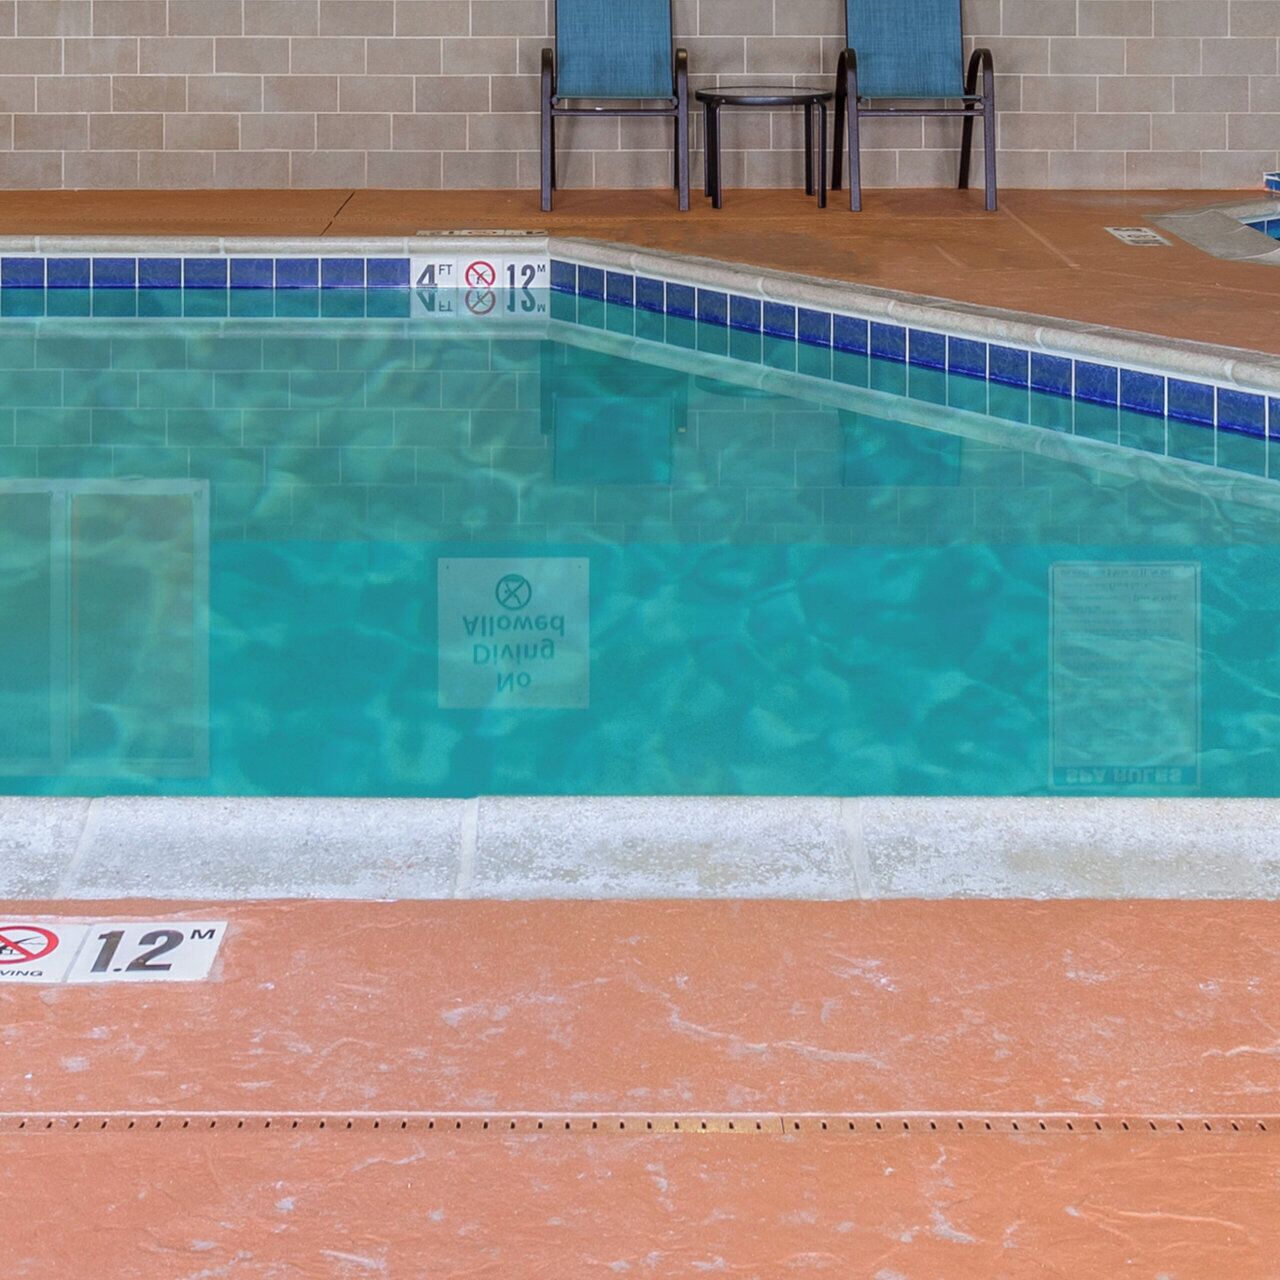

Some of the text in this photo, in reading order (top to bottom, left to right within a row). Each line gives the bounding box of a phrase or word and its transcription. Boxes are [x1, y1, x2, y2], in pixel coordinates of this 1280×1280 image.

[416, 264, 438, 288] 4
[438, 263, 453, 275] FT
[537, 264, 546, 273] M
[89, 929, 185, 973] 1.2
[190, 928, 217, 940] M
